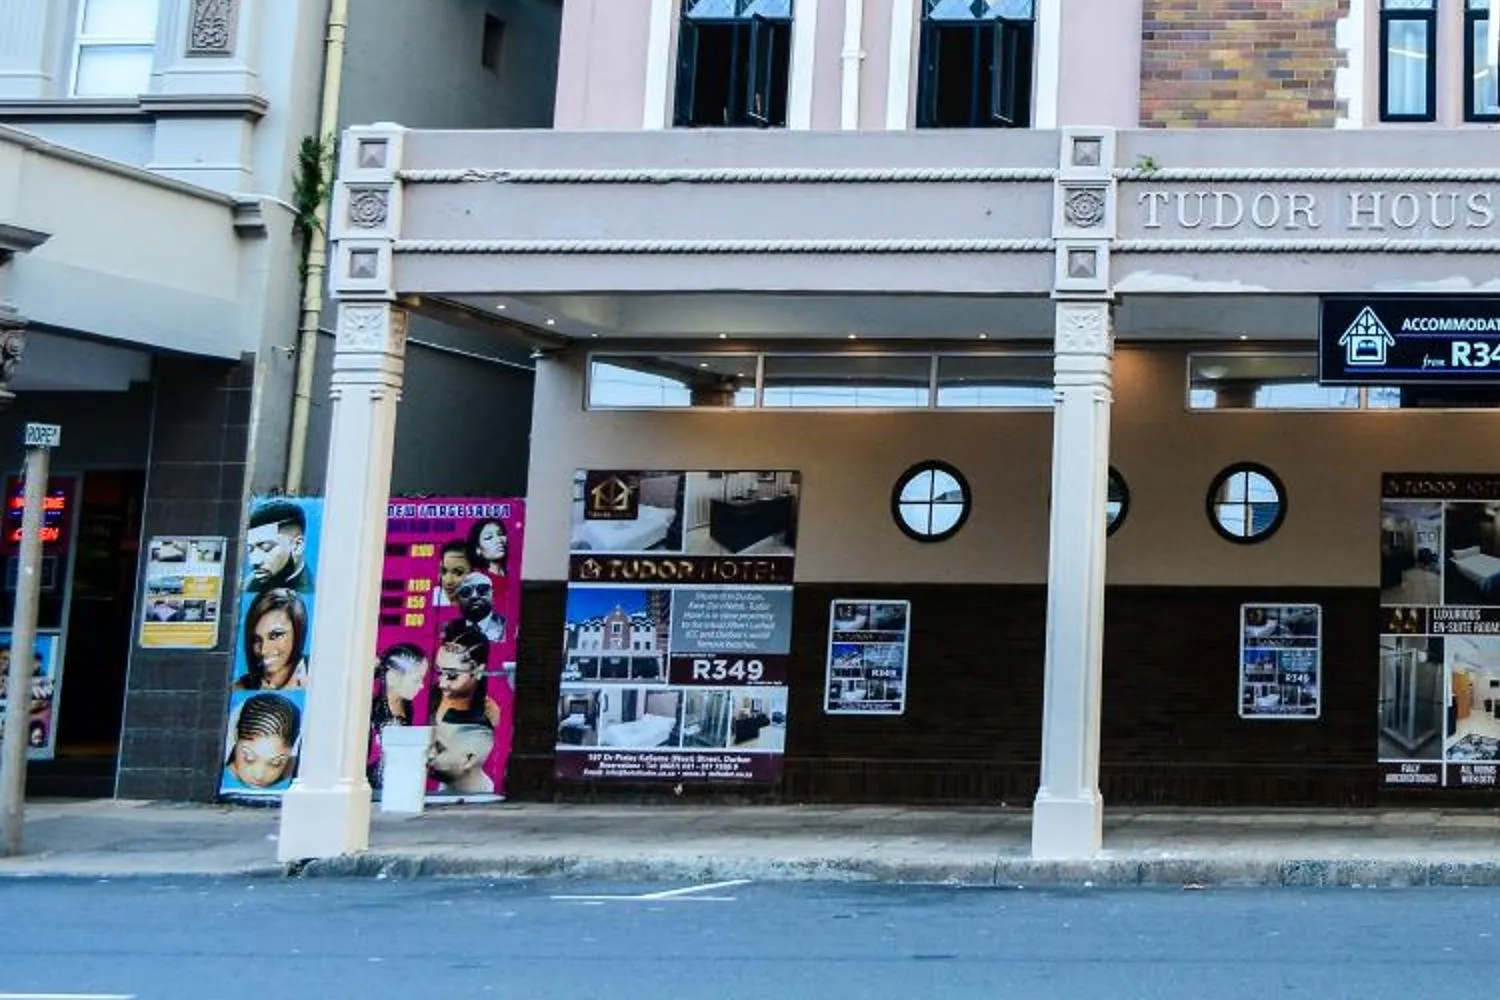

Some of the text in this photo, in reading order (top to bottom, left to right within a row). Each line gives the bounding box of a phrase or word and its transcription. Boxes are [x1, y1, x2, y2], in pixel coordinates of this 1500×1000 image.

[1138, 191, 1320, 231] TUDOR
[609, 560, 782, 580] TUDOR HOTEL
[1433, 621, 1473, 633] EN-SUITE
[693, 659, 764, 680] R349
